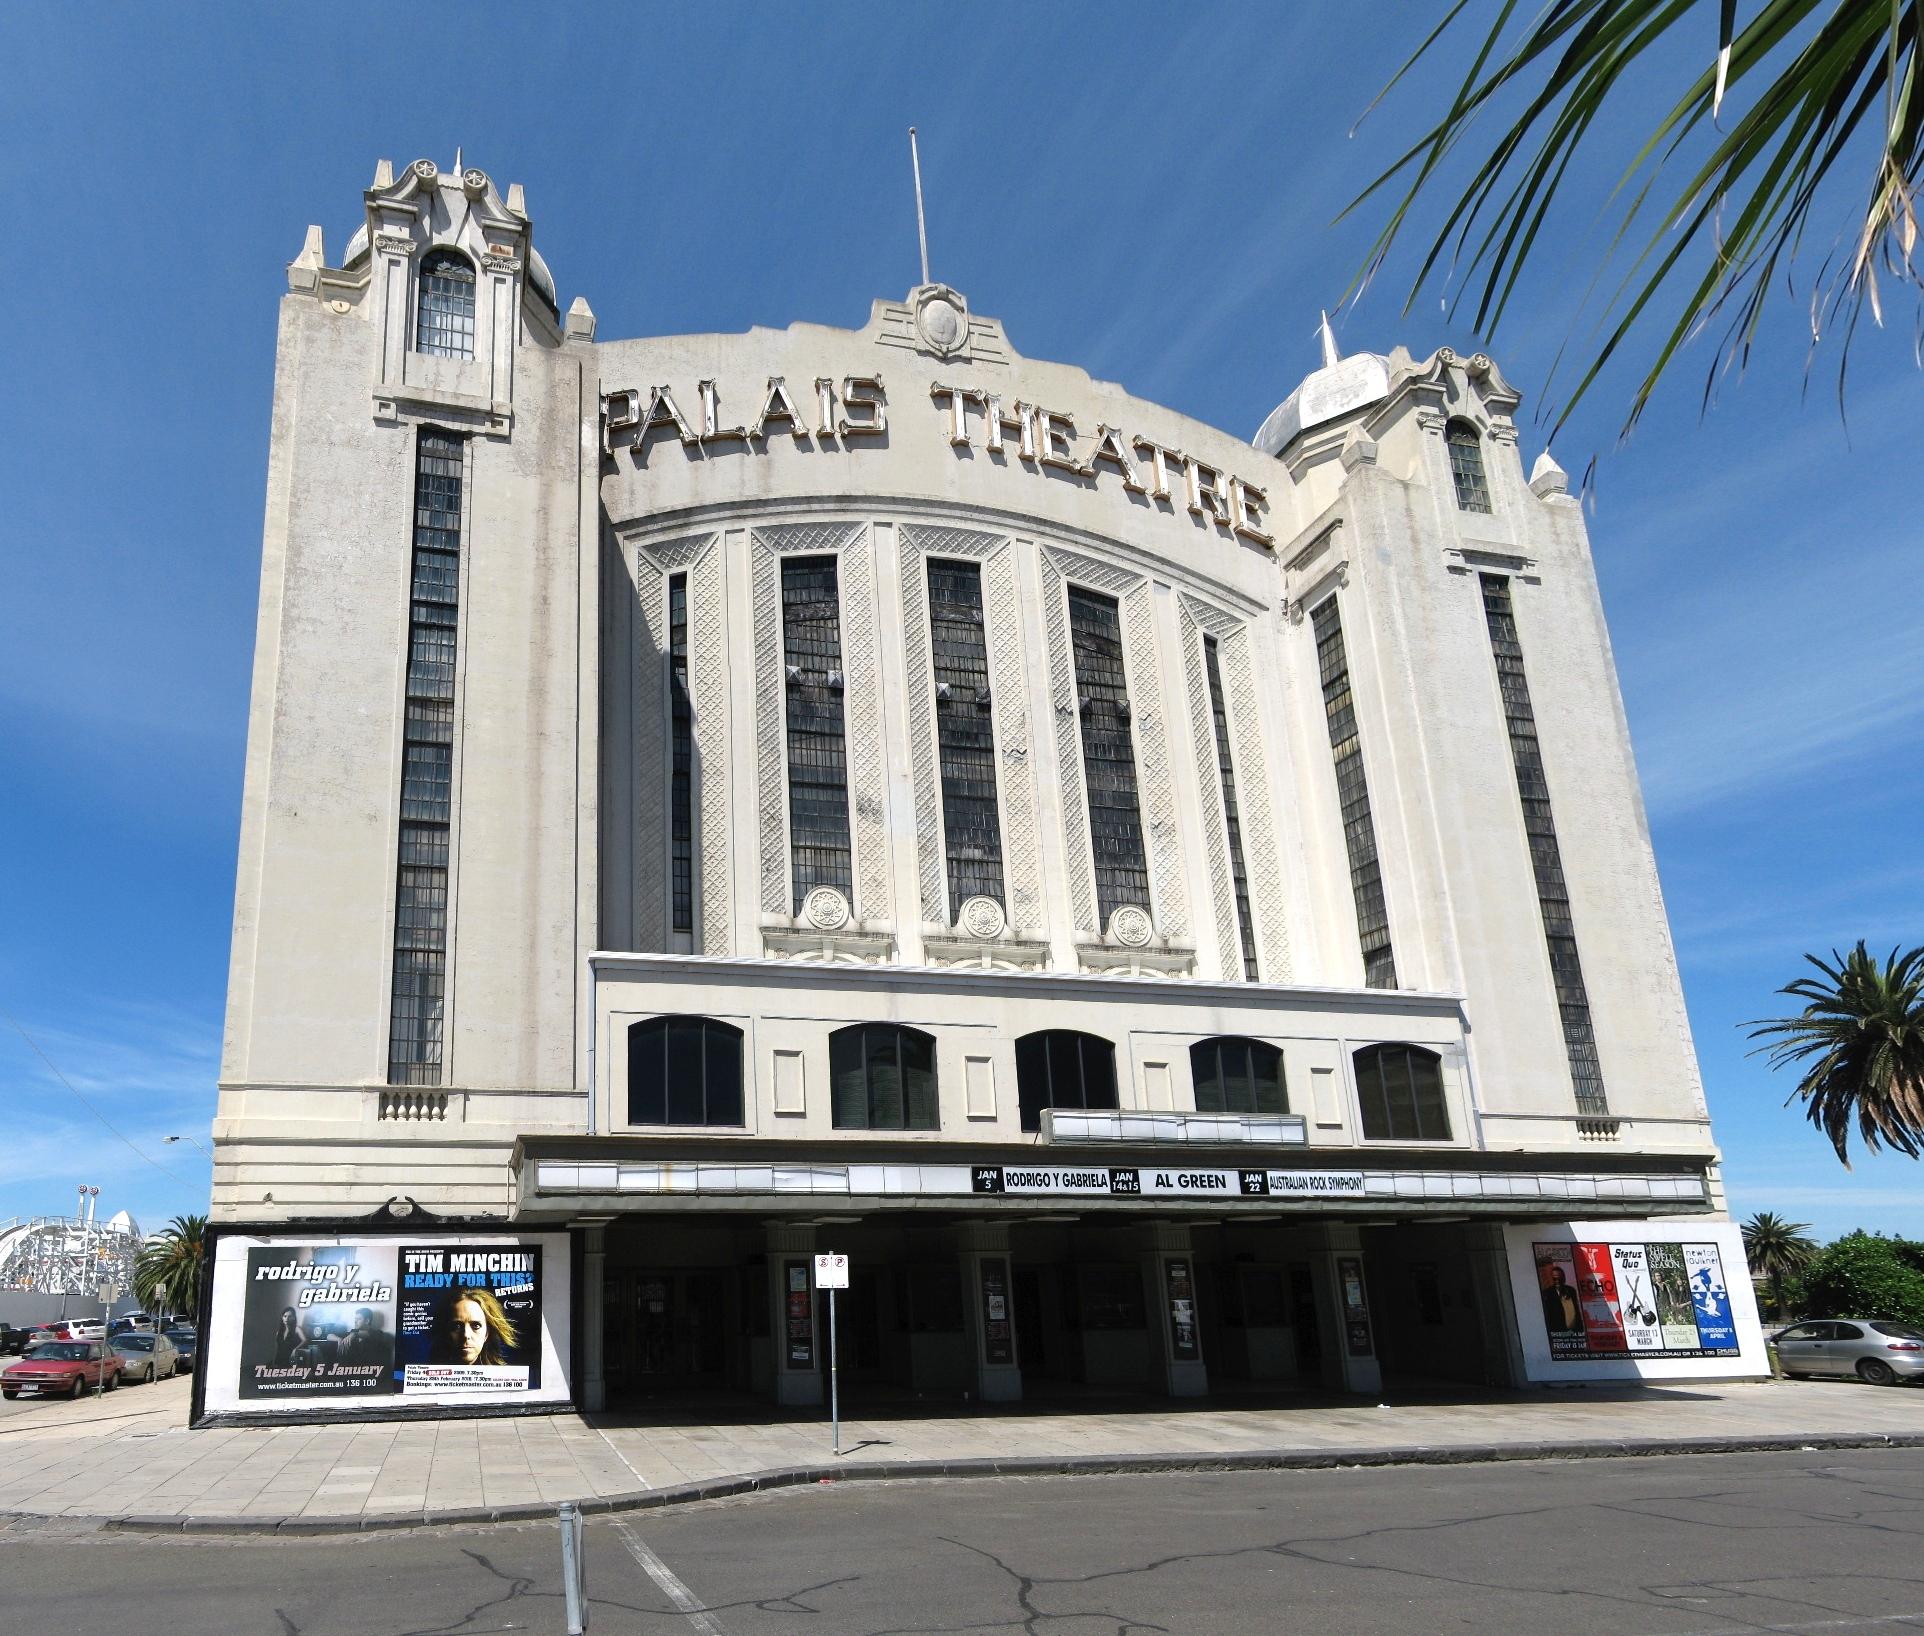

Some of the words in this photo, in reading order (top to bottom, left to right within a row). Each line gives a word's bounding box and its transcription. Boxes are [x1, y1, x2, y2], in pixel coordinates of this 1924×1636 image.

[599, 373, 886, 455] PALAIS
[930, 381, 1275, 549] THEATRE
[977, 1170, 997, 1180] JAN
[1006, 1172, 1051, 1187] RODRIGO
[1053, 1173, 1060, 1187] Y
[1062, 1173, 1109, 1188] GABRIELA
[1115, 1172, 1133, 1181] JAN
[1244, 1174, 1262, 1183] JAN
[985, 1181, 992, 1189] 5
[1112, 1182, 1139, 1191] 14&15
[1155, 1174, 1174, 1188] AL
[1177, 1174, 1227, 1189] GREEN
[1269, 1176, 1308, 1190] AUSTRALIAN
[1309, 1176, 1328, 1191] ROCK
[1328, 1177, 1363, 1191] SYMPHONY
[1249, 1183, 1261, 1192] 22
[1614, 1248, 1642, 1259] Status
[1649, 1244, 1666, 1255] THE
[1685, 1249, 1717, 1257] newton
[405, 1254, 443, 1273] TIM
[450, 1253, 535, 1272] MINCHIN
[1622, 1258, 1639, 1269] Quo
[1649, 1260, 1682, 1269] SEASON
[255, 1260, 339, 1284] rodrigo
[344, 1265, 359, 1284] y
[404, 1273, 454, 1289] READY
[458, 1273, 486, 1287] FOR
[490, 1272, 535, 1287] THIS?
[298, 1281, 391, 1308] gabriela
[494, 1282, 535, 1297] RETURNS
[1628, 1329, 1651, 1338] SATURDAY
[1637, 1337, 1653, 1345] MARCH
[255, 1365, 312, 1379] Tuesday
[314, 1363, 326, 1376] 5
[327, 1363, 385, 1378] January
[257, 1381, 344, 1390] www.ticketmaster.com.au
[362, 1379, 377, 1387] 100
